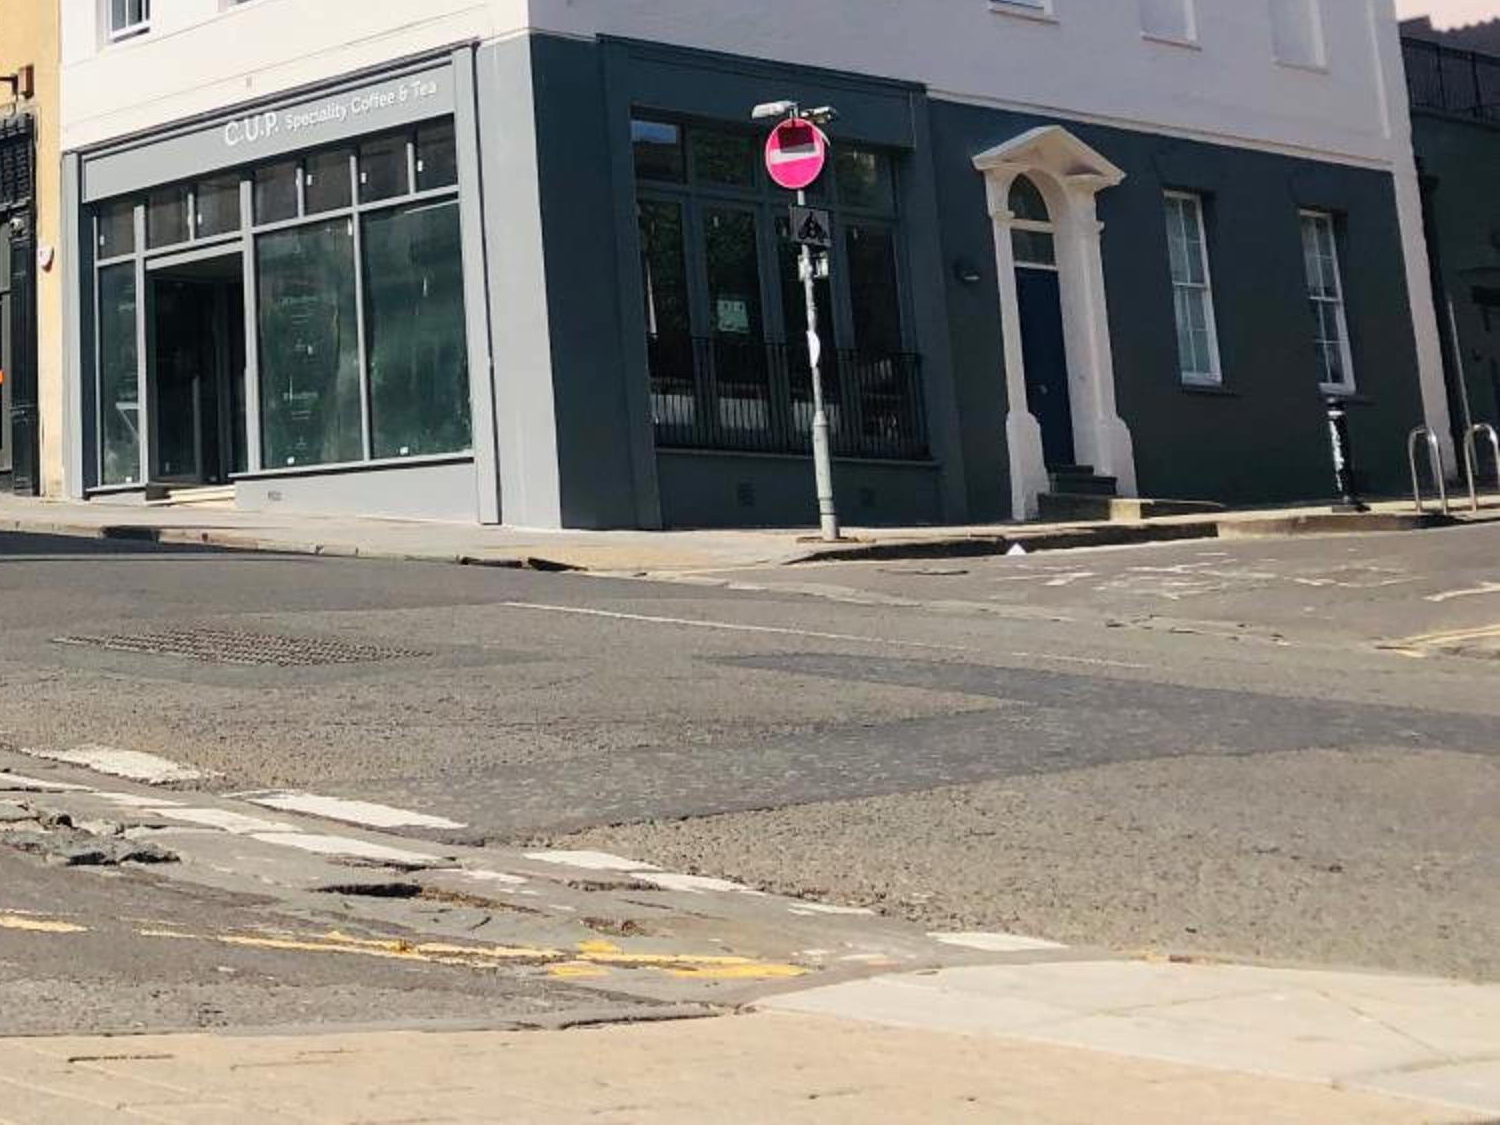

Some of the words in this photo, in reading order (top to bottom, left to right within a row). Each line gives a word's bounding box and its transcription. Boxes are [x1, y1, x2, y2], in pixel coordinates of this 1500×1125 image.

[224, 112, 279, 145] C.U.P.
[286, 101, 347, 132] Speciality
[350, 89, 396, 114] Coffee
[413, 80, 437, 97] Tea
